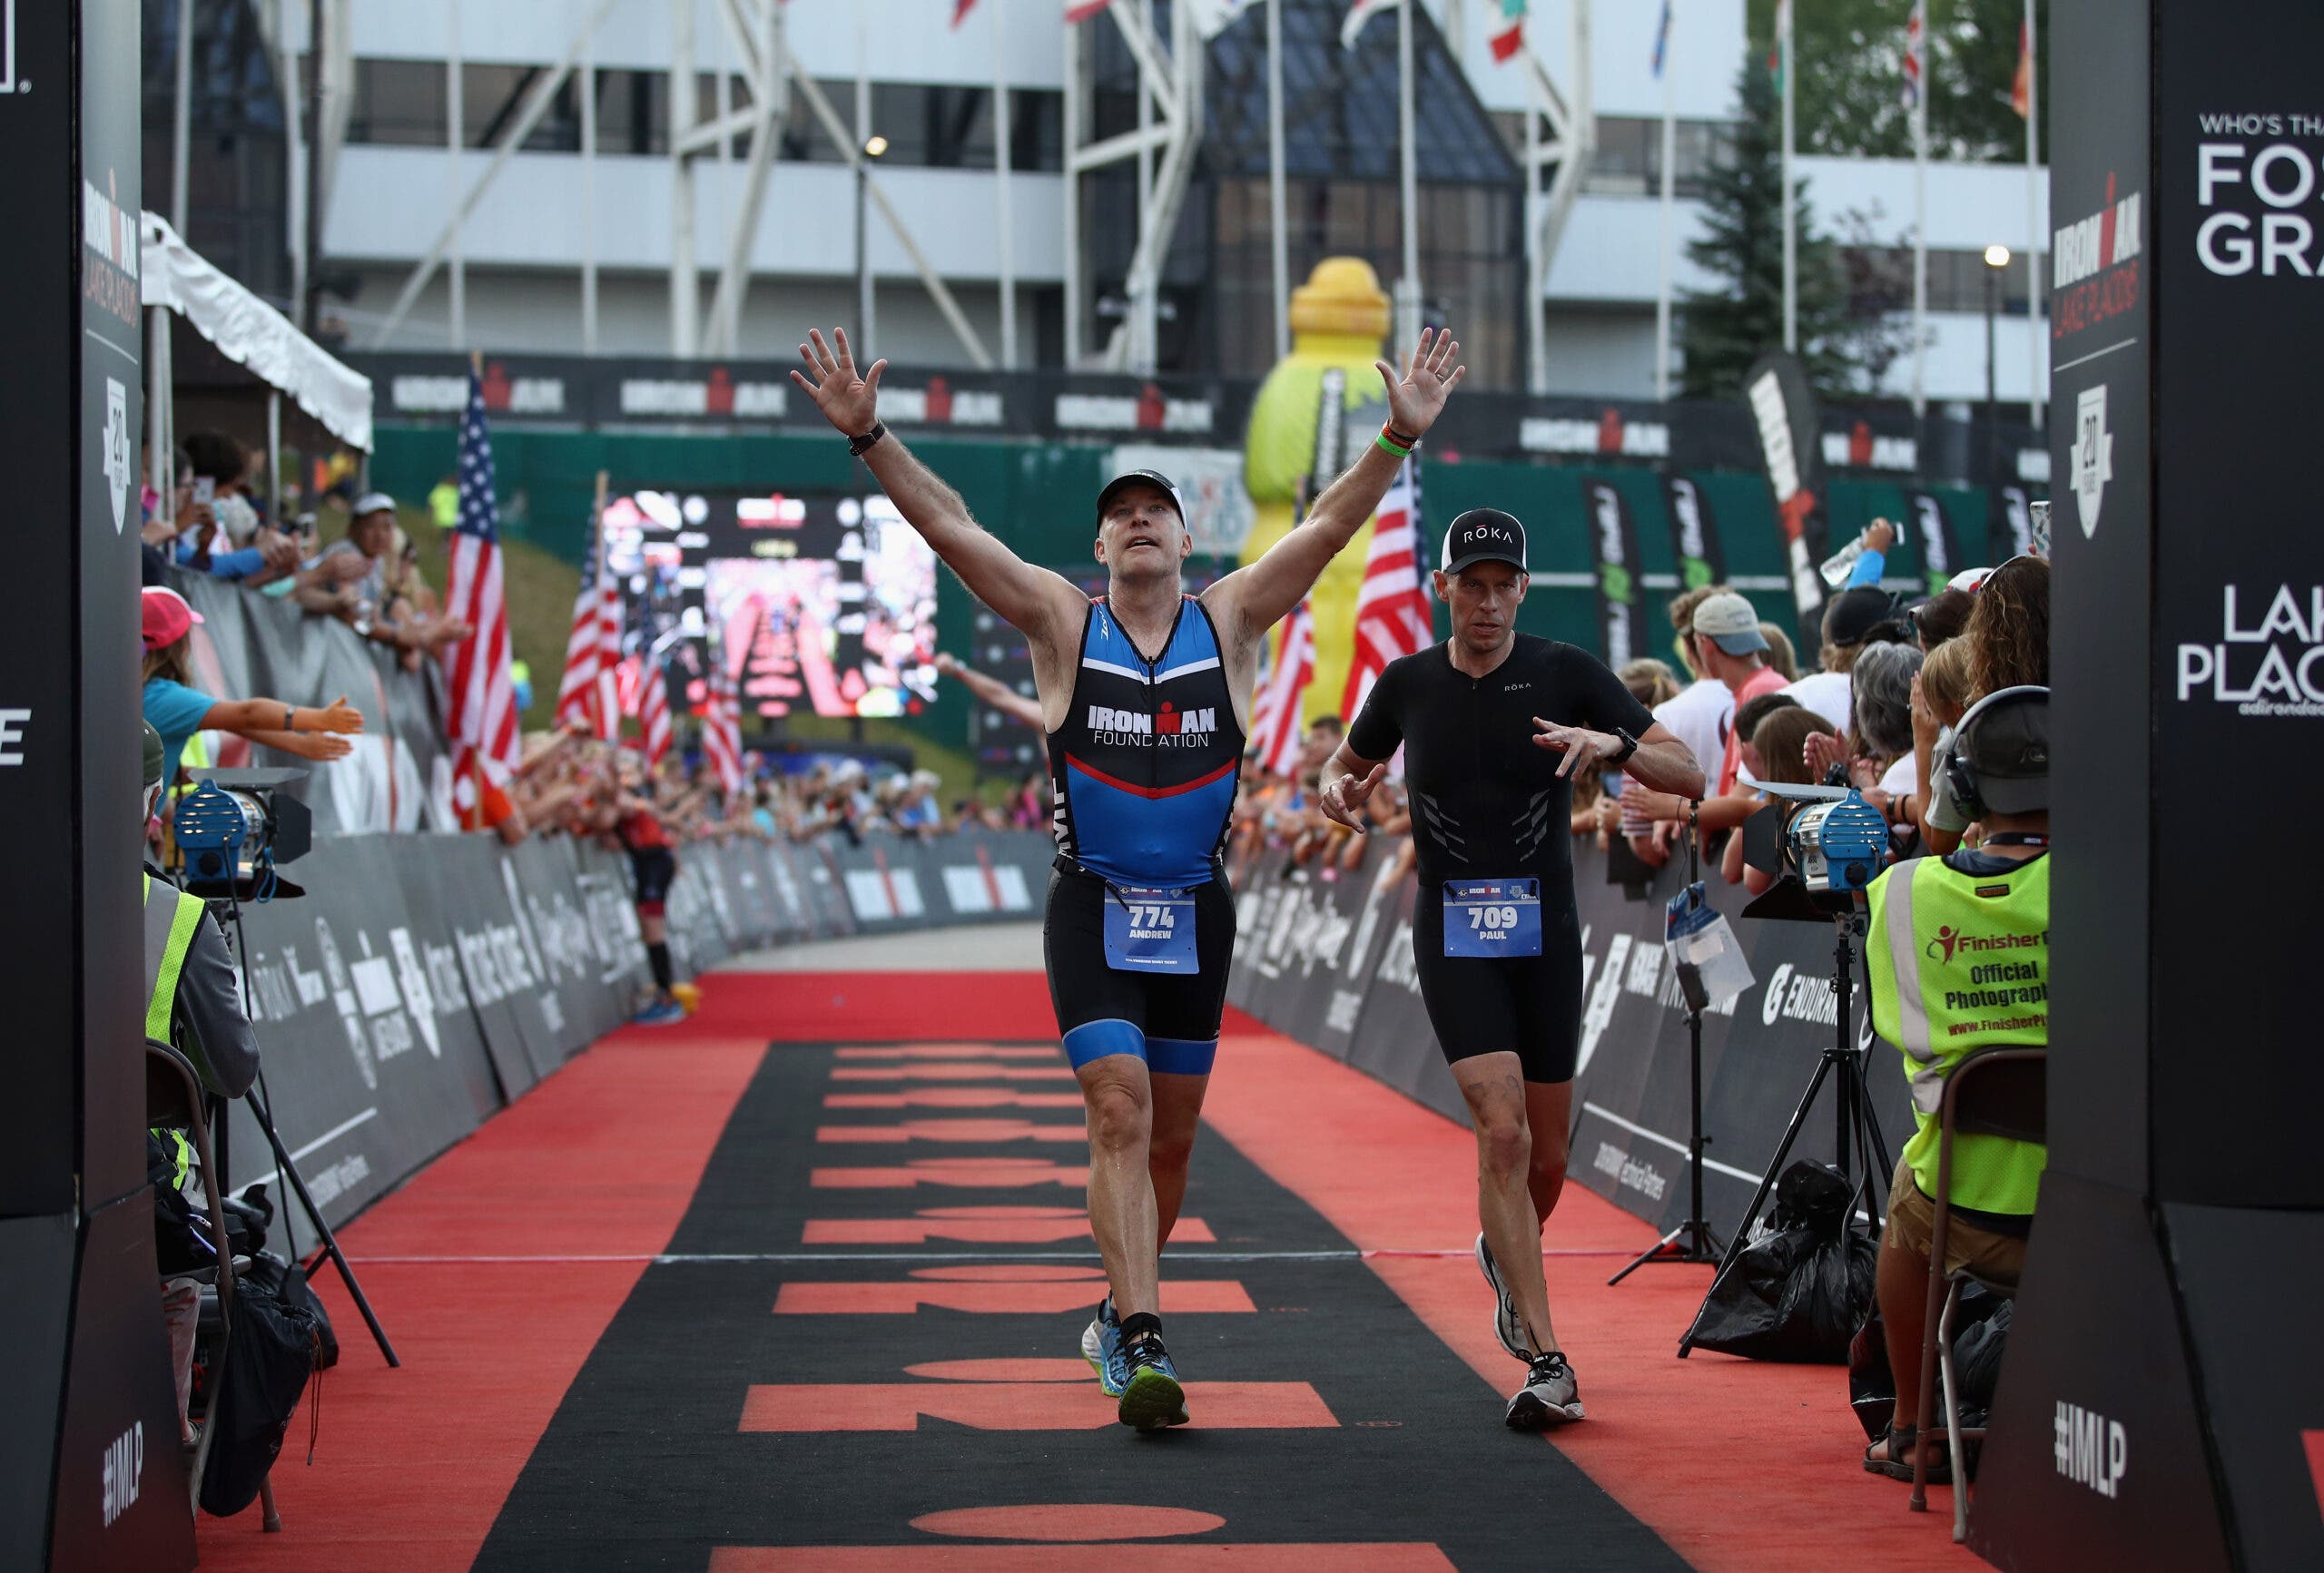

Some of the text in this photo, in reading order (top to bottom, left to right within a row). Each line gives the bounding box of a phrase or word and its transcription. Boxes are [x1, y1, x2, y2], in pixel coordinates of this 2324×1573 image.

[2199, 113, 2324, 137] WHO'S TH
[2198, 143, 2324, 209] FO
[2195, 211, 2324, 277] GR
[1088, 700, 1216, 735] IRONMAN
[1128, 906, 1175, 928] 774
[1468, 906, 1518, 929] 709
[1128, 929, 1172, 939] ANDREW
[1479, 931, 1507, 940] PAUL
[1970, 960, 2039, 985] Official
[1782, 974, 1860, 1026] ENDURAN
[2053, 1400, 2128, 1500] #IMLP
[103, 1420, 143, 1529] #IMLP
